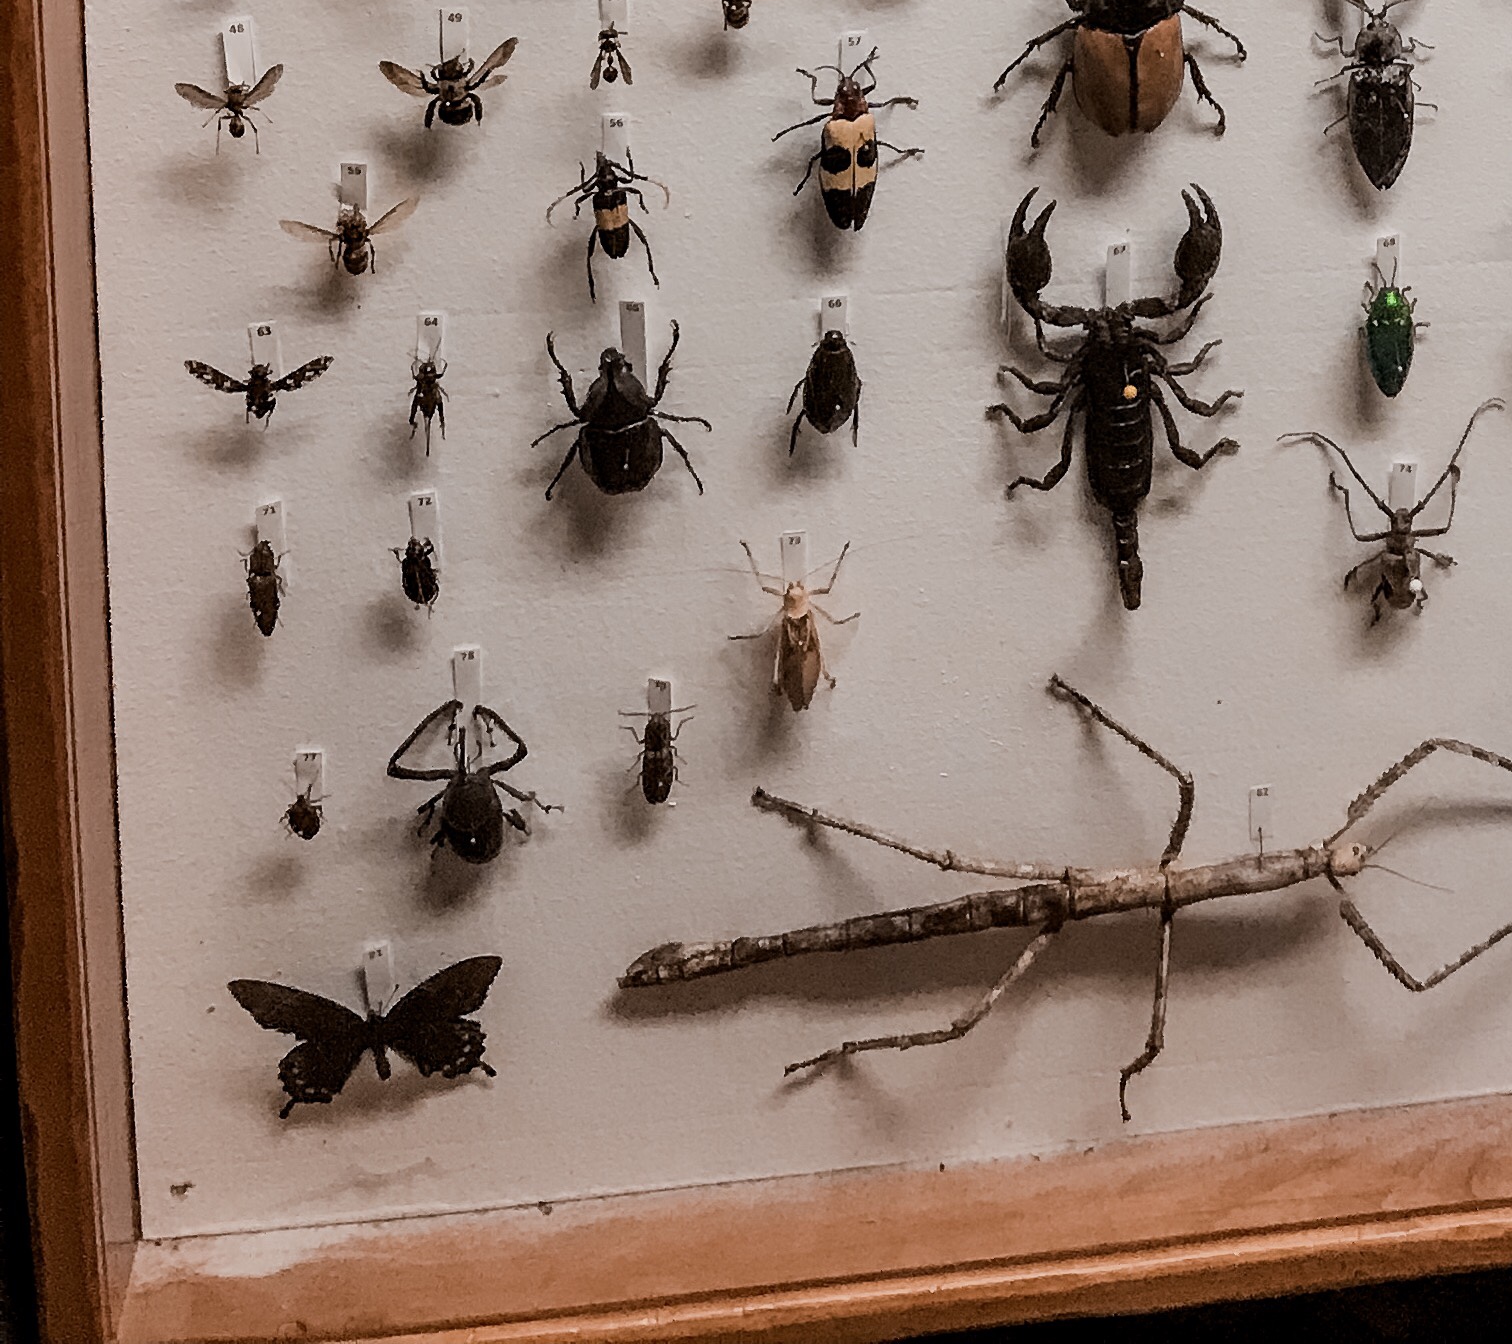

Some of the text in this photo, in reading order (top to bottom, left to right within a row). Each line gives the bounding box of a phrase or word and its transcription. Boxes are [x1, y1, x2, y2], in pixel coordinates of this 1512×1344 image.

[447, 12, 463, 23] 49
[848, 35, 862, 47] 57
[609, 118, 624, 128] 56
